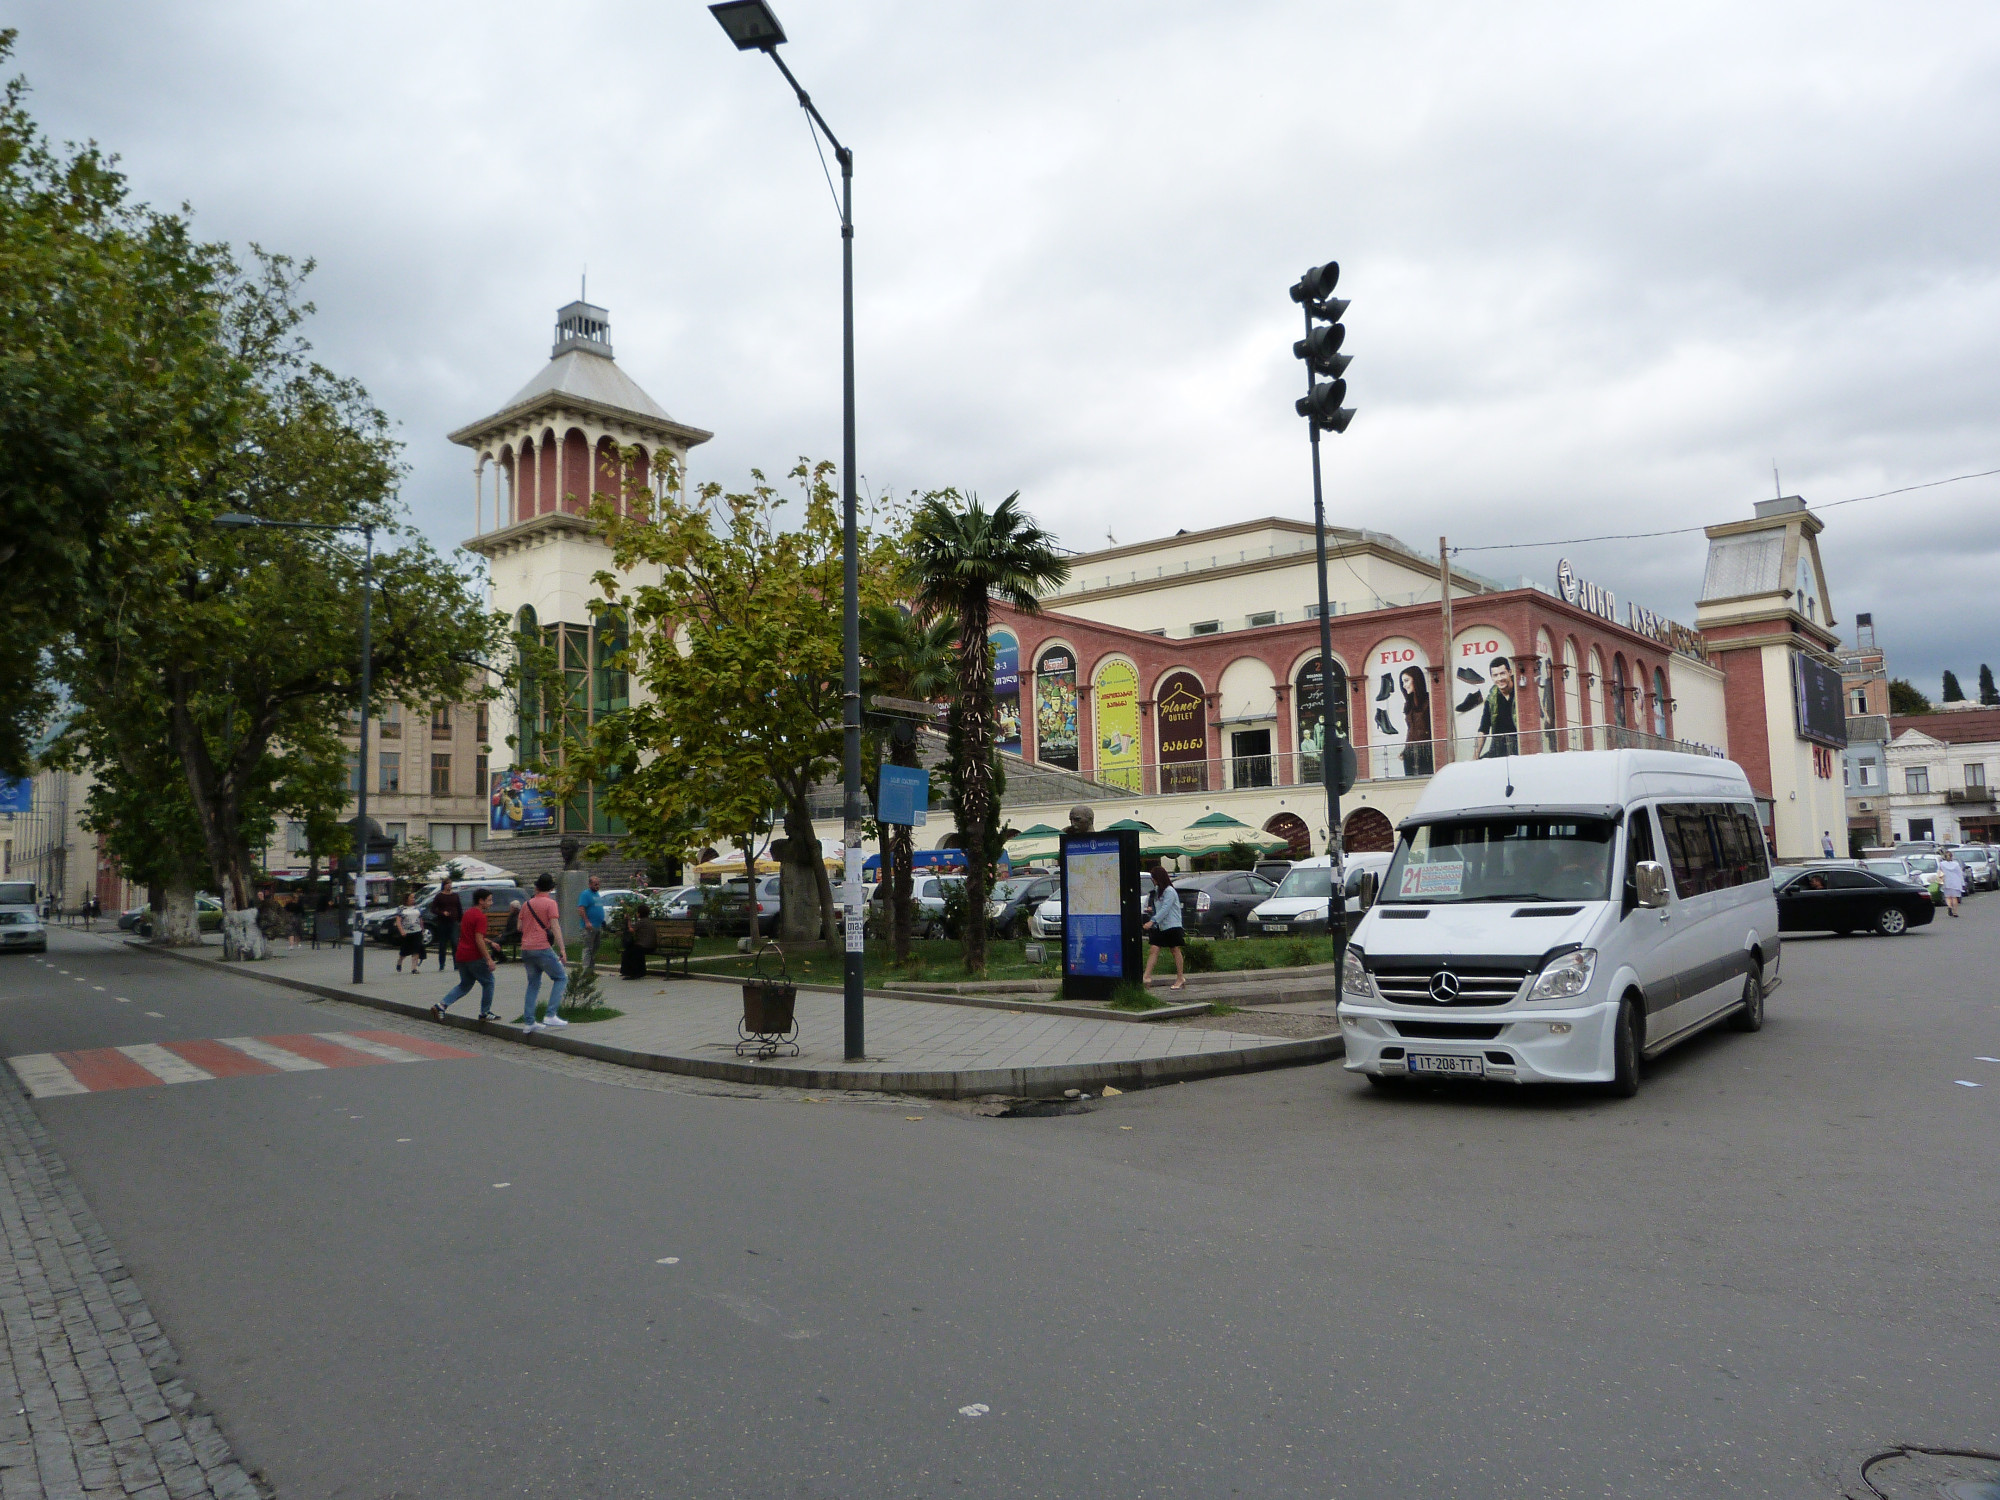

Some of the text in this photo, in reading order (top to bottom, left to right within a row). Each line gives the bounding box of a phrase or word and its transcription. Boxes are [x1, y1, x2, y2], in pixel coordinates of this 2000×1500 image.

[1462, 640, 1499, 656] FLO
[1537, 640, 1548, 654] FLO
[1380, 649, 1415, 664] FLO
[1160, 700, 1201, 717] planet
[1168, 712, 1193, 721] OUTLET
[1162, 738, 1204, 752] გახსნა
[1812, 742, 1833, 780] FLO
[1401, 867, 1422, 893] 21
